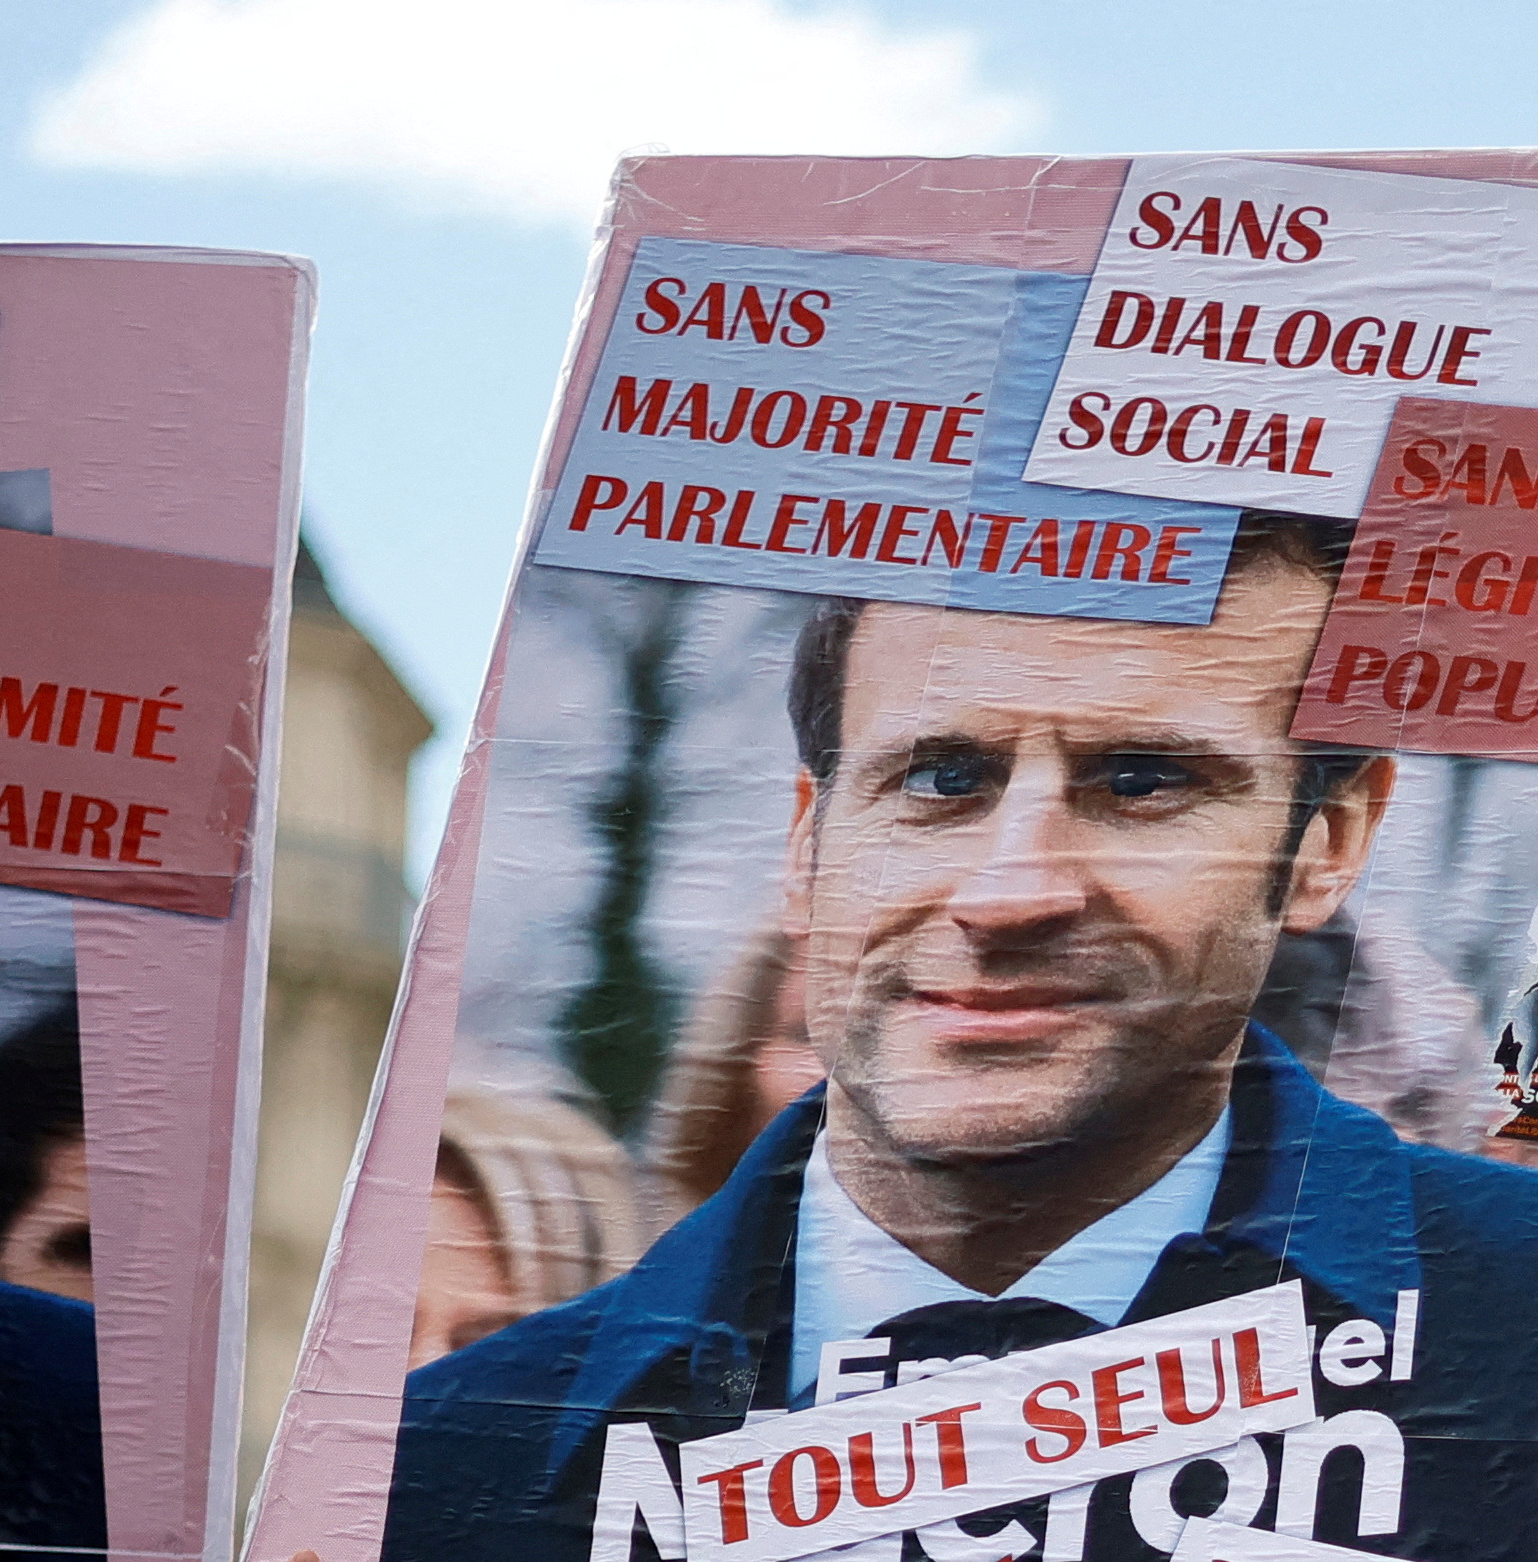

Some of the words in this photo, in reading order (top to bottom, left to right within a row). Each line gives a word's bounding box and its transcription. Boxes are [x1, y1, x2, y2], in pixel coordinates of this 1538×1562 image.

[1129, 191, 1329, 264] SANS
[635, 276, 831, 347] SANS
[1093, 290, 1493, 387] DIALOGUE
[602, 375, 985, 466] MAJORITÉ
[1060, 392, 1334, 478] SOCIAL
[568, 474, 1201, 586] PARLEMENTAIRE
[697, 1402, 982, 1545] TOUT
[1022, 1327, 1300, 1464] SEUL
